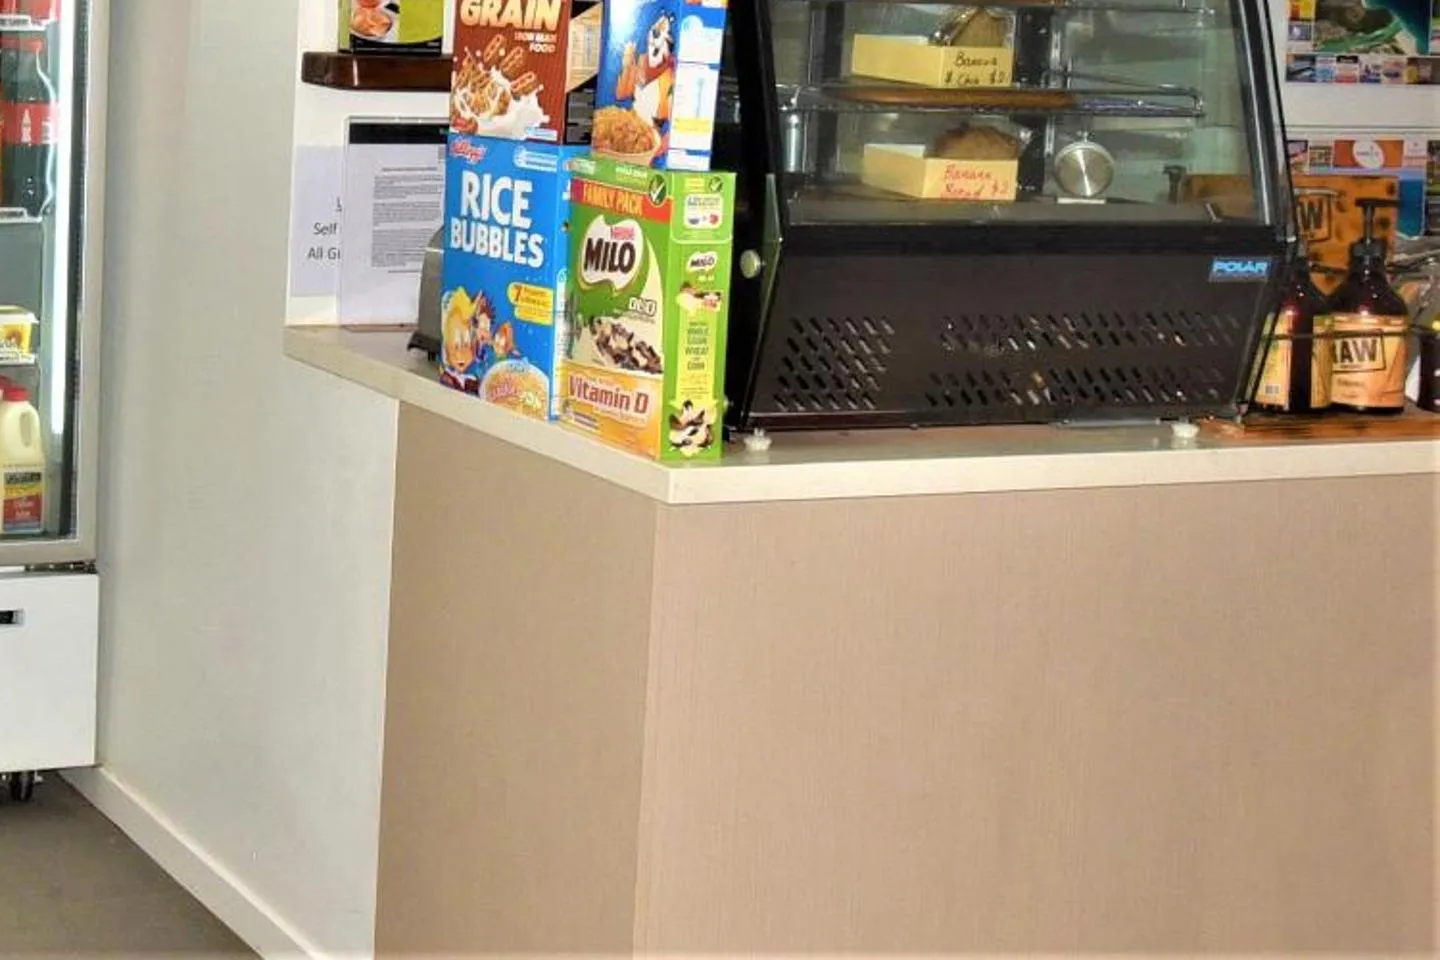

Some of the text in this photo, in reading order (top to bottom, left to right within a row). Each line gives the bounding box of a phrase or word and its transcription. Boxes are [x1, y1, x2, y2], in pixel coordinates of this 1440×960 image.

[461, 169, 533, 230] RICE
[314, 222, 337, 236] Self
[449, 217, 545, 269] BUBBLES
[307, 248, 323, 260] All
[583, 237, 637, 275] MILO
[1212, 259, 1270, 274] POLAR
[568, 374, 649, 414] Vitamin D
